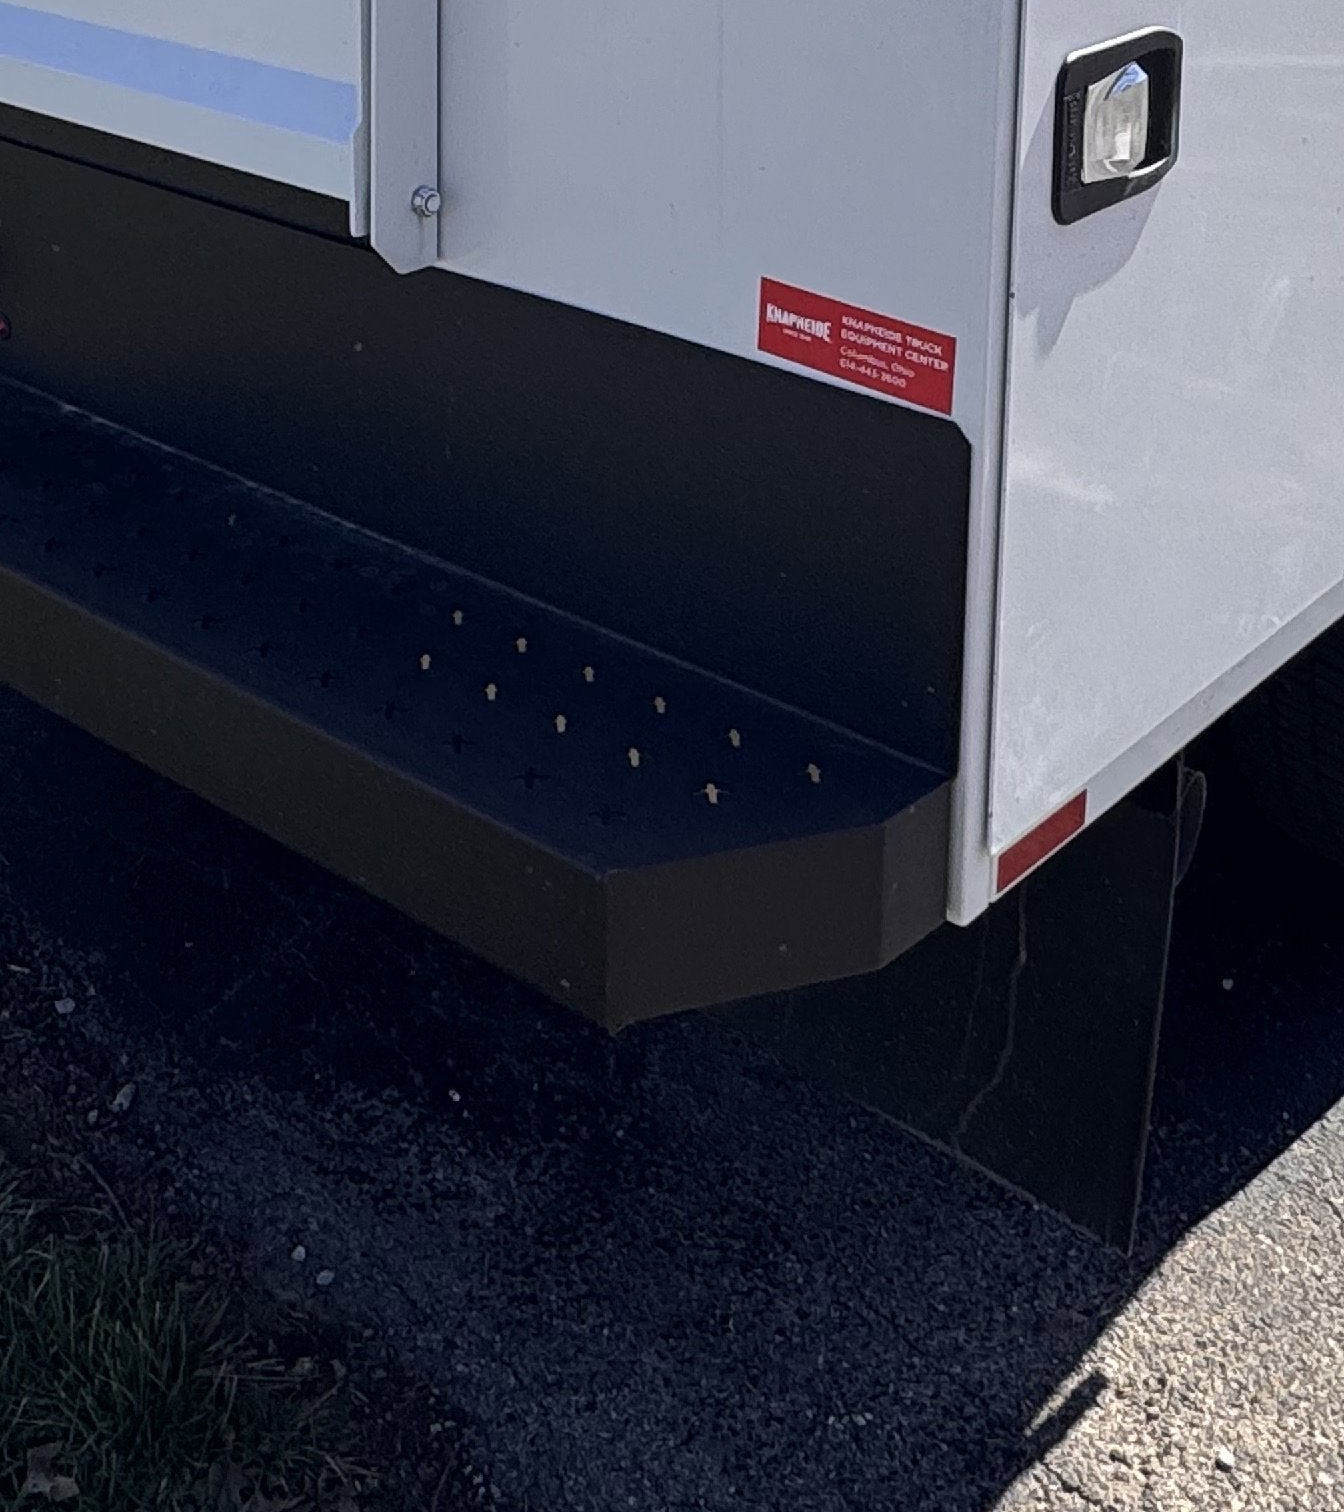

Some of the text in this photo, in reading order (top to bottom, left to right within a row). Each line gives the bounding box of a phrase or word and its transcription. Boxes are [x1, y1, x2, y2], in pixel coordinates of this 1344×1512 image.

[765, 302, 832, 344] KNAPHEIDE
[840, 328, 903, 357] EQUIPMENT
[904, 350, 950, 371] CENTER
[905, 335, 943, 357] TRUCK
